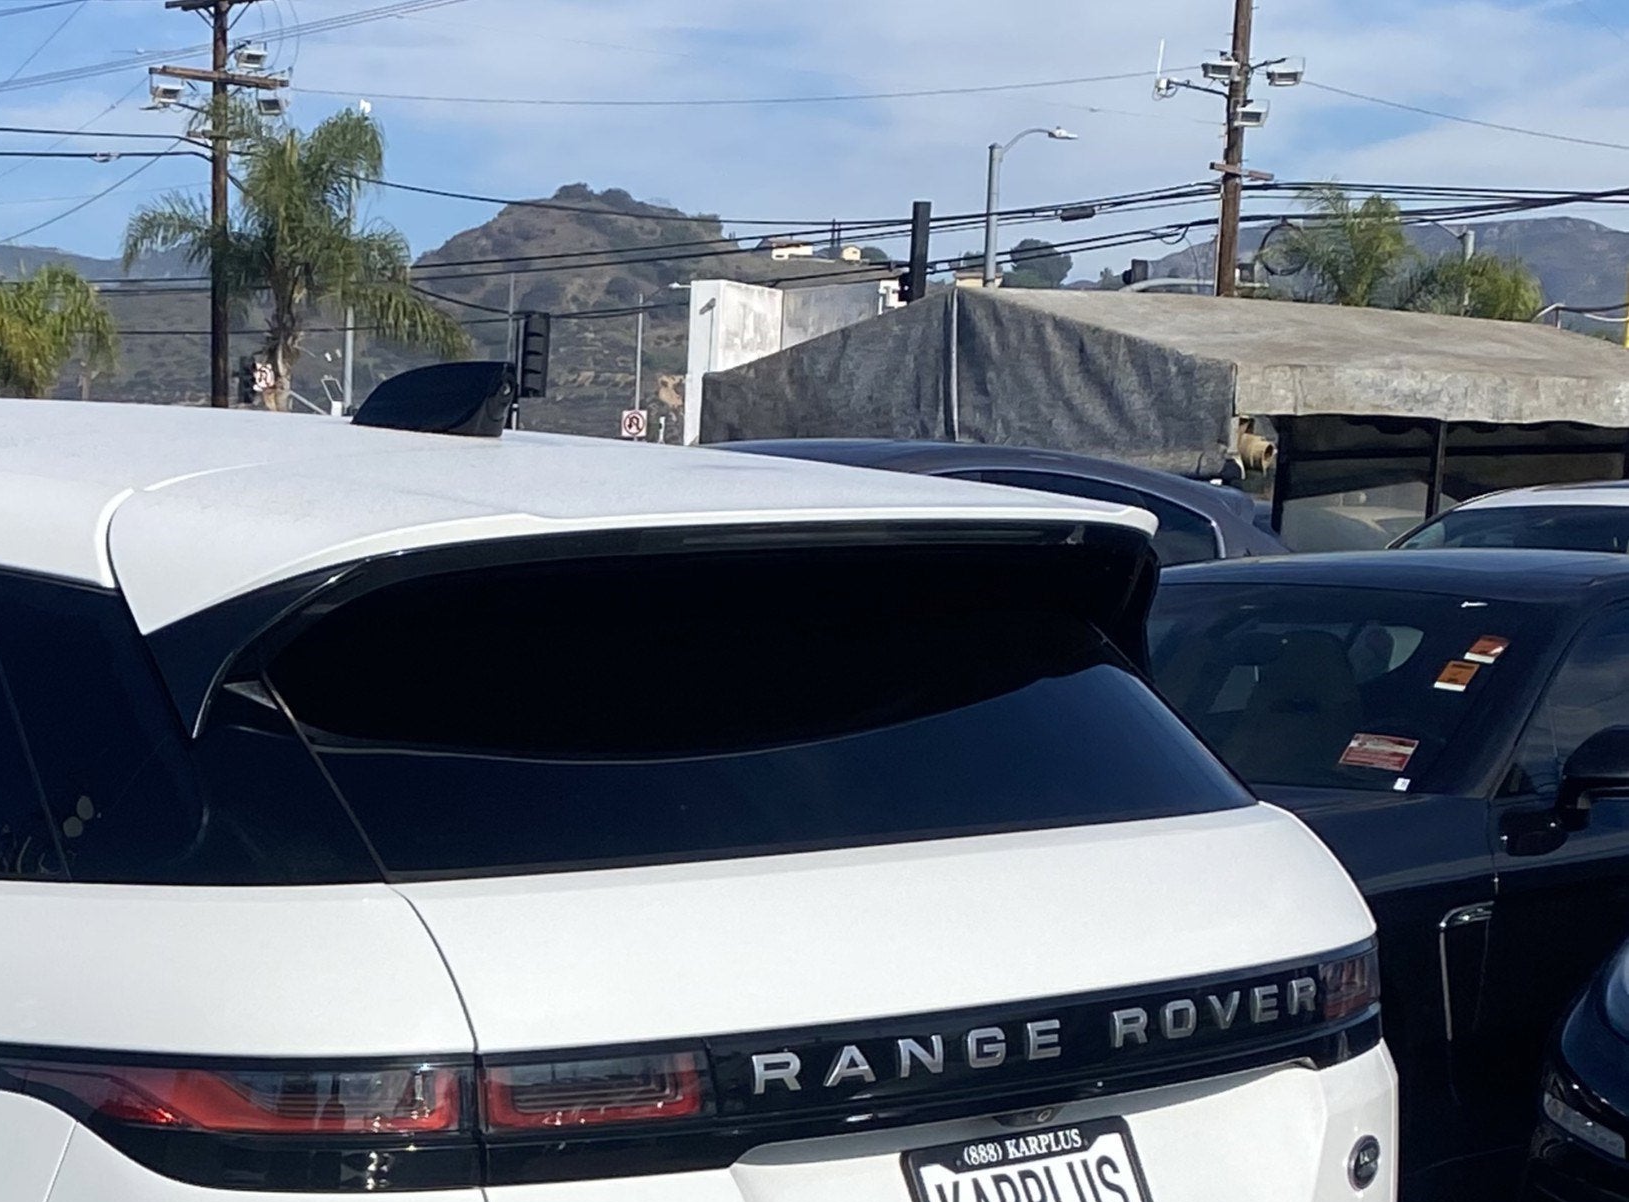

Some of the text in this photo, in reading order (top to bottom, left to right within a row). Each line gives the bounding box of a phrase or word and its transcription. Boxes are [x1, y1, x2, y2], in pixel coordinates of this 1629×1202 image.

[752, 977, 1318, 1095] RANGE ROVER
[963, 1128, 1083, 1167] (888) KARPLUS
